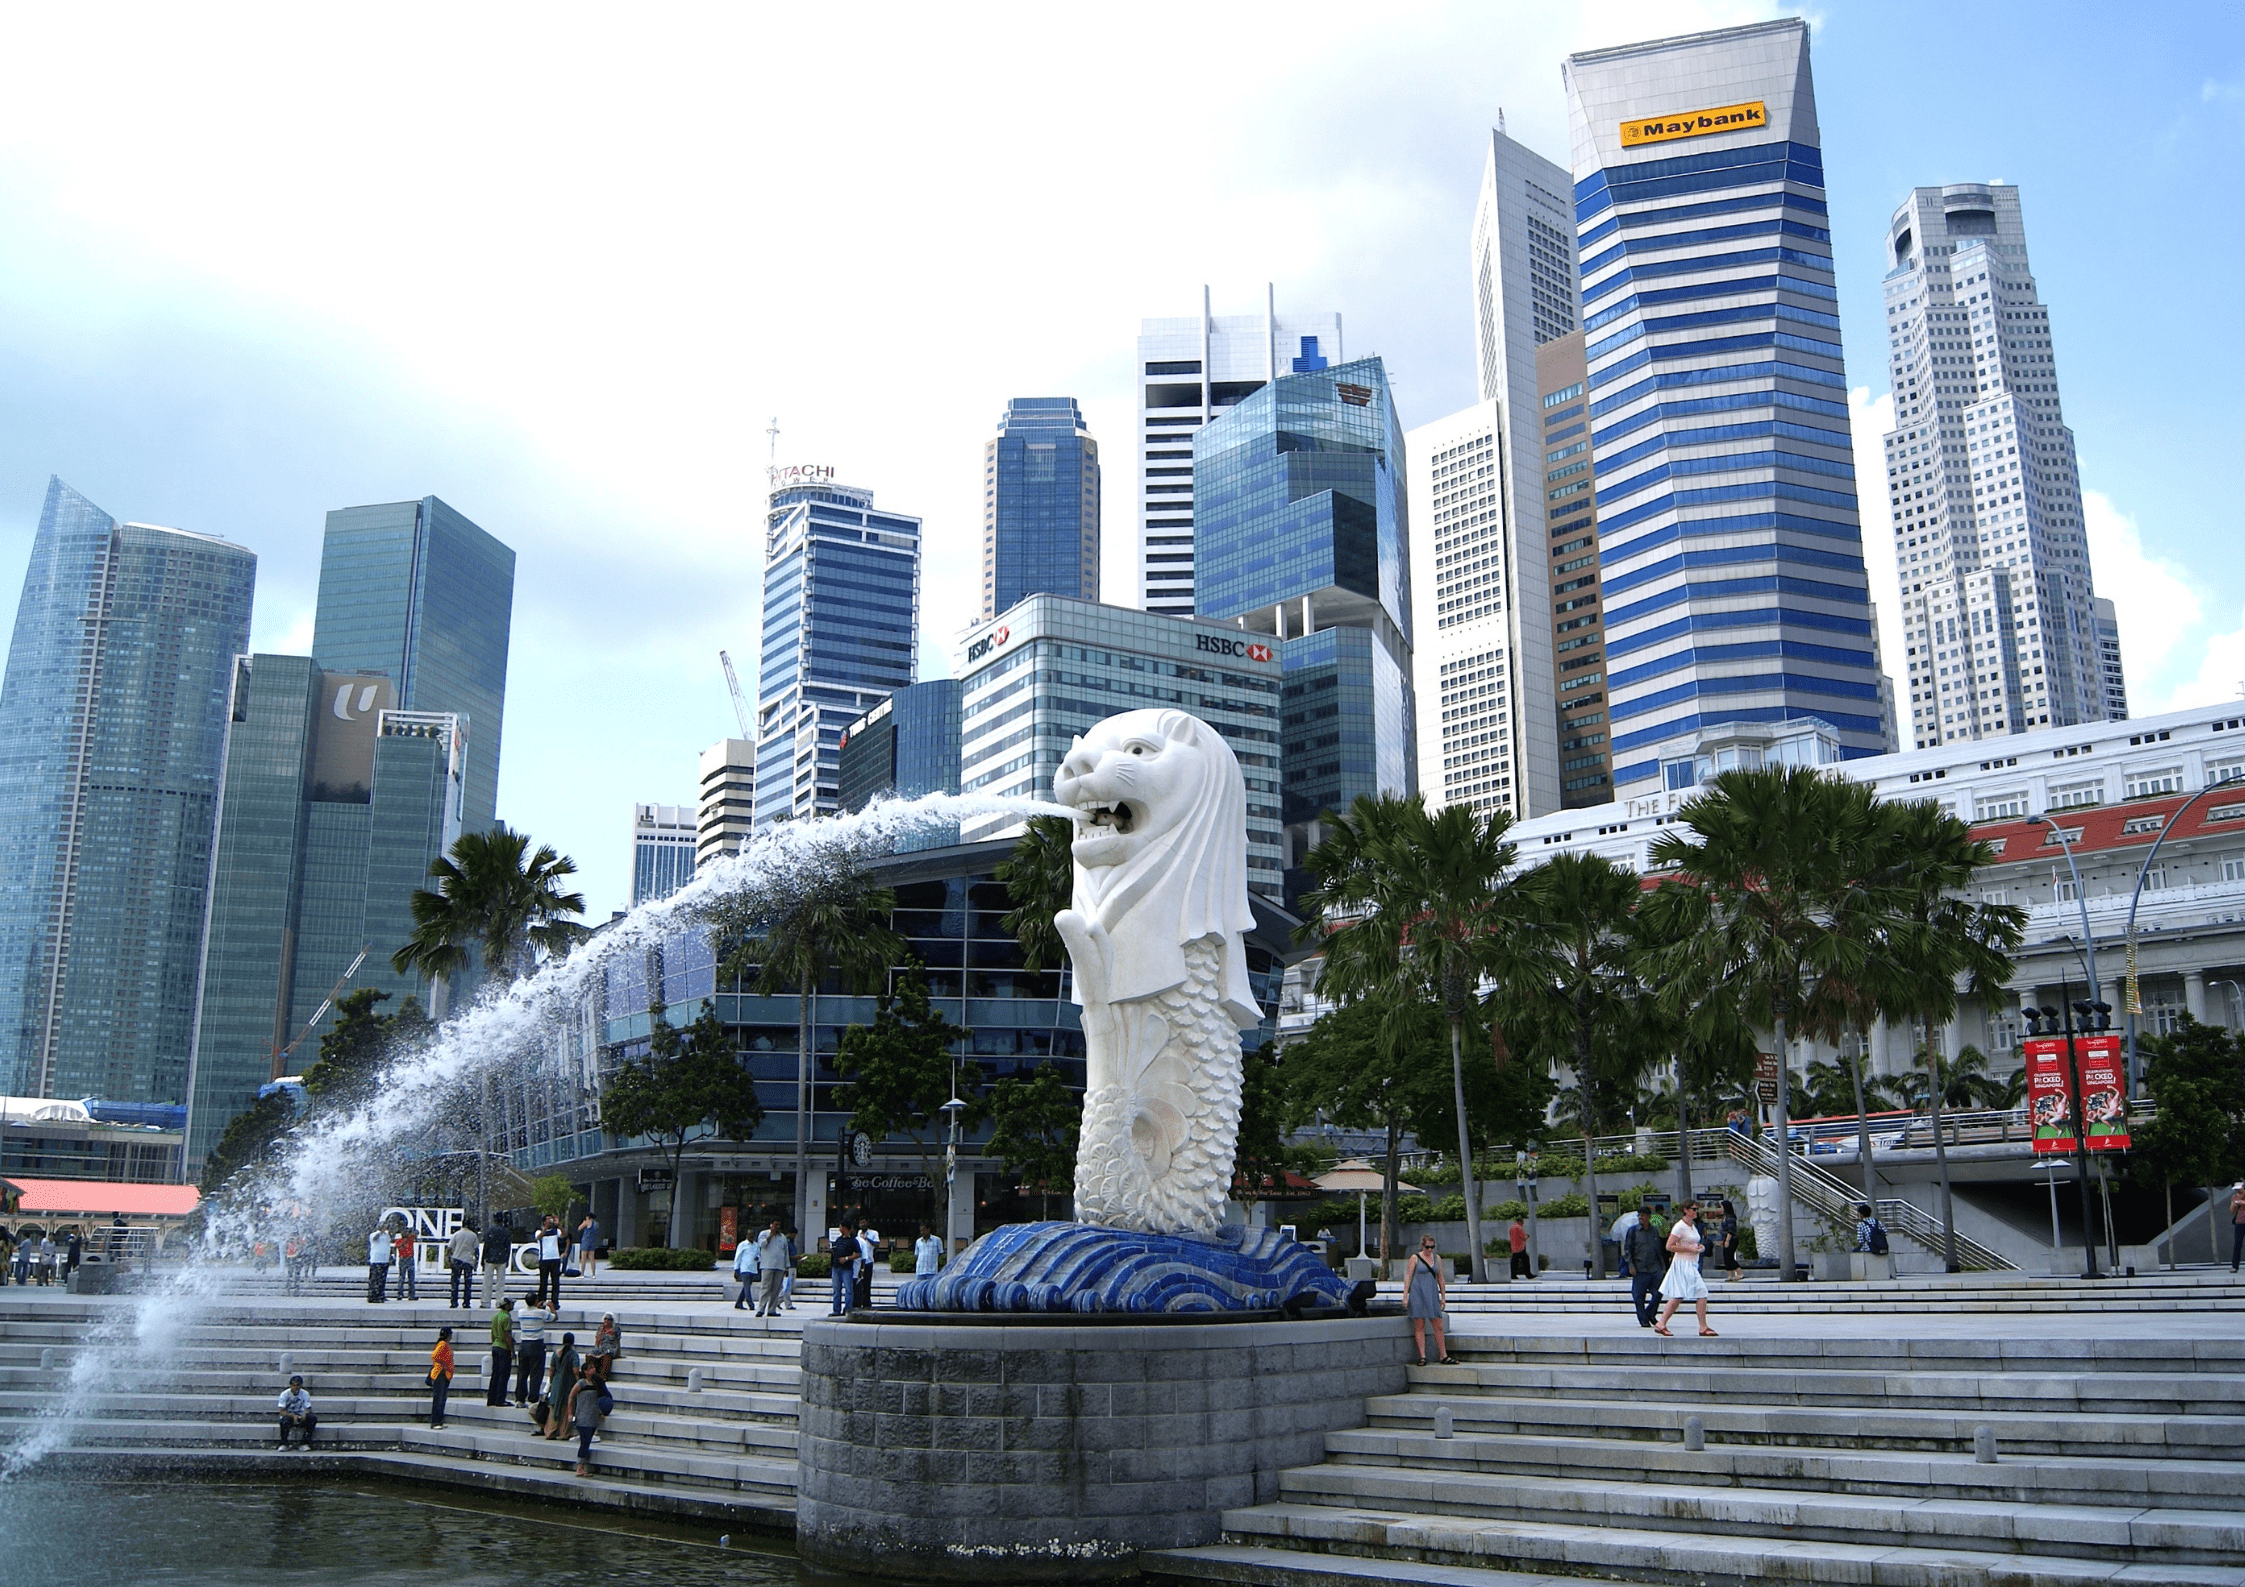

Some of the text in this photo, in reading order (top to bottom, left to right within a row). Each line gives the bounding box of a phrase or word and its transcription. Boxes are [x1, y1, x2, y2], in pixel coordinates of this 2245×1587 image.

[1643, 109, 1761, 136] Maybank
[968, 633, 994, 664] HSBC
[1196, 633, 1245, 657] HSBC
[1624, 799, 1660, 818] THE
[871, 1176, 912, 1188] Coffee
[914, 1176, 949, 1188] Ben
